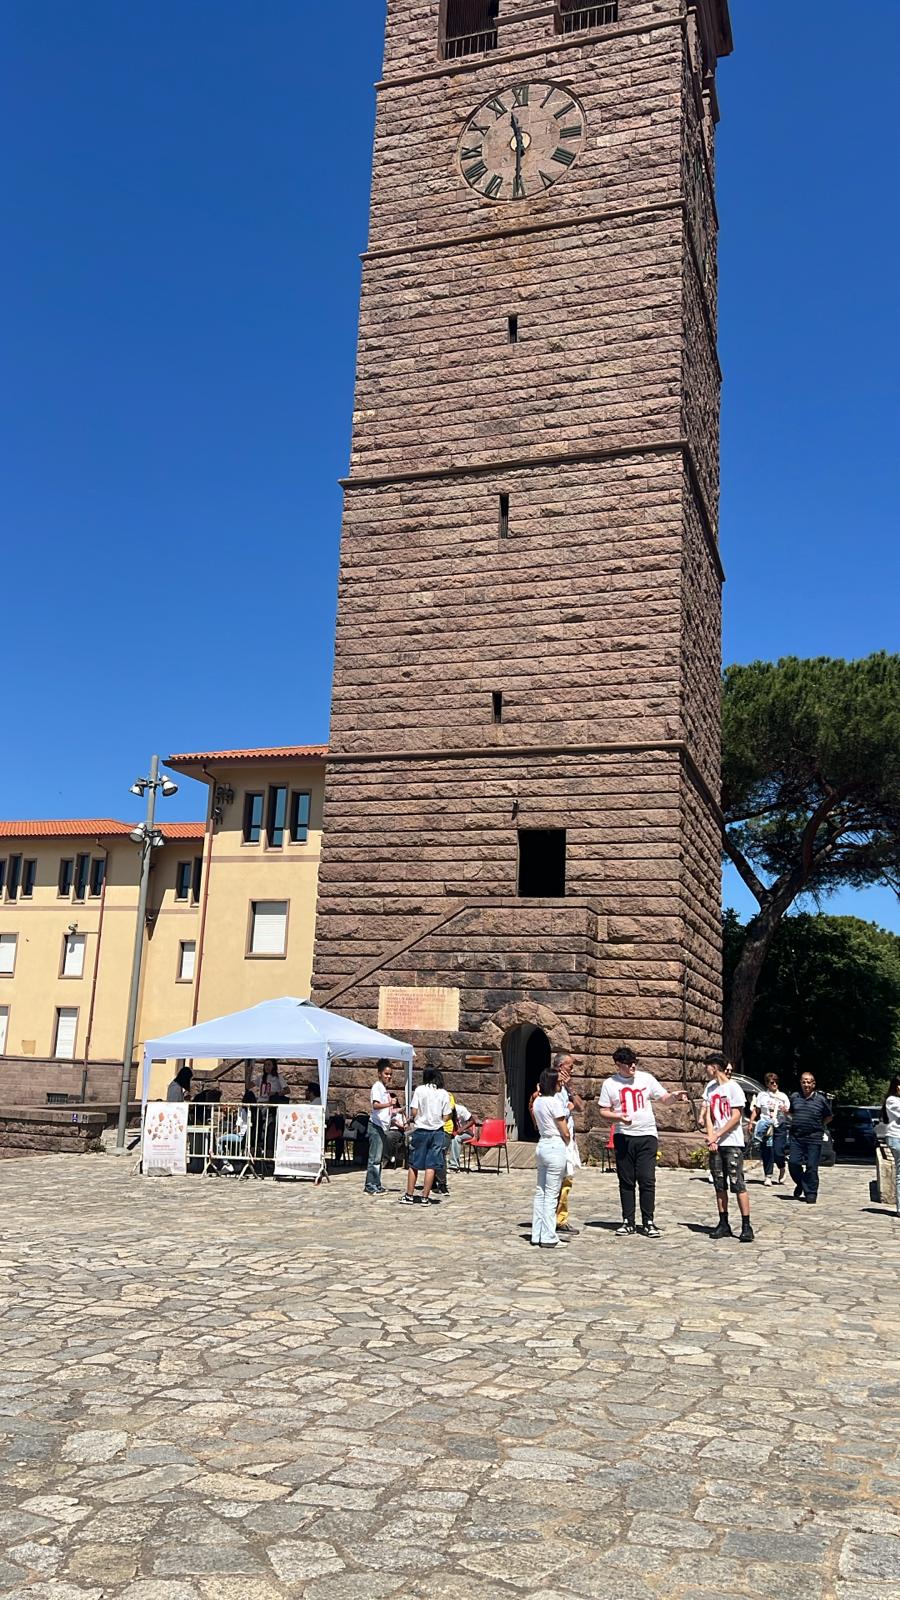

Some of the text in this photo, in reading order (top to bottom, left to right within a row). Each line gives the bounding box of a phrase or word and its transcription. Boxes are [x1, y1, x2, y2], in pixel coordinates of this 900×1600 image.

[511, 85, 529, 109] XII
[540, 86, 556, 108] I
[485, 97, 508, 120] XI
[553, 100, 576, 120] II
[467, 120, 490, 136] X
[559, 125, 582, 138] III
[461, 144, 482, 160] IX
[484, 174, 503, 199] VII
[538, 170, 555, 190] V
